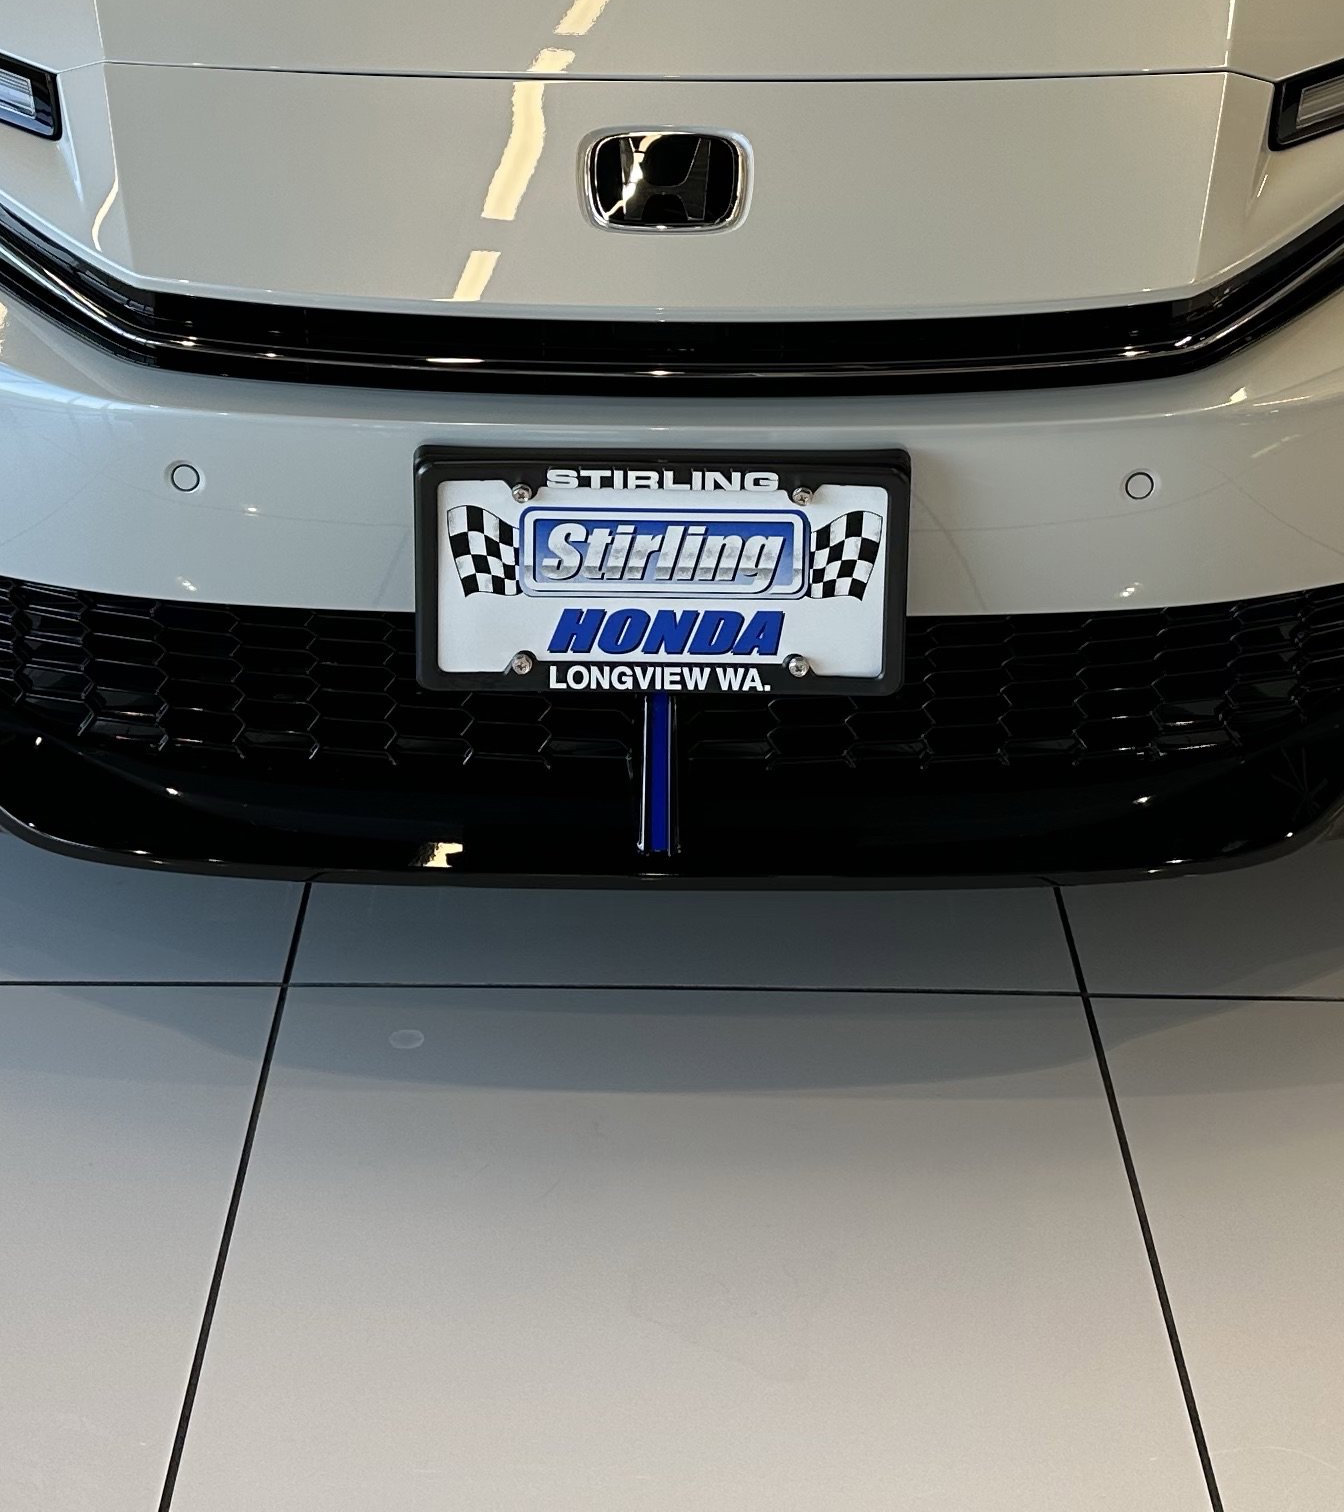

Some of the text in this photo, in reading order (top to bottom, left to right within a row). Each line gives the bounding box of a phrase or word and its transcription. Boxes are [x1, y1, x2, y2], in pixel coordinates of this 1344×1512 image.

[546, 469, 779, 491] STIRLING
[541, 522, 786, 590] Stirling
[547, 608, 785, 656] HONDA
[549, 665, 771, 691] LONGVIEW WA.
